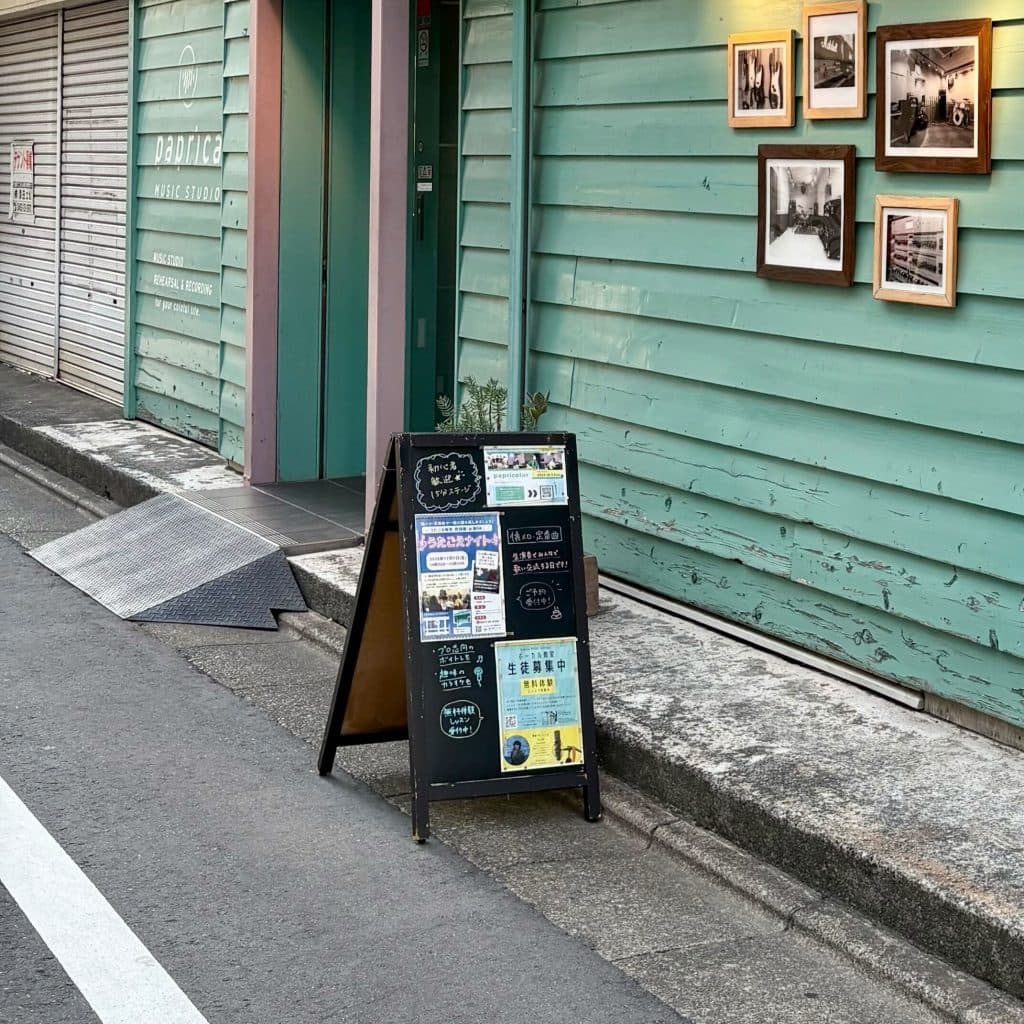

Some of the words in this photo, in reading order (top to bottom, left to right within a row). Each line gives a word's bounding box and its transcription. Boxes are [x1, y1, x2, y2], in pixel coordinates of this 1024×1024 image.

[155, 125, 222, 171] paprica
[154, 183, 181, 199] MUSIC
[185, 184, 221, 201] STUDIO
[507, 658, 566, 676] 生徒募集中
